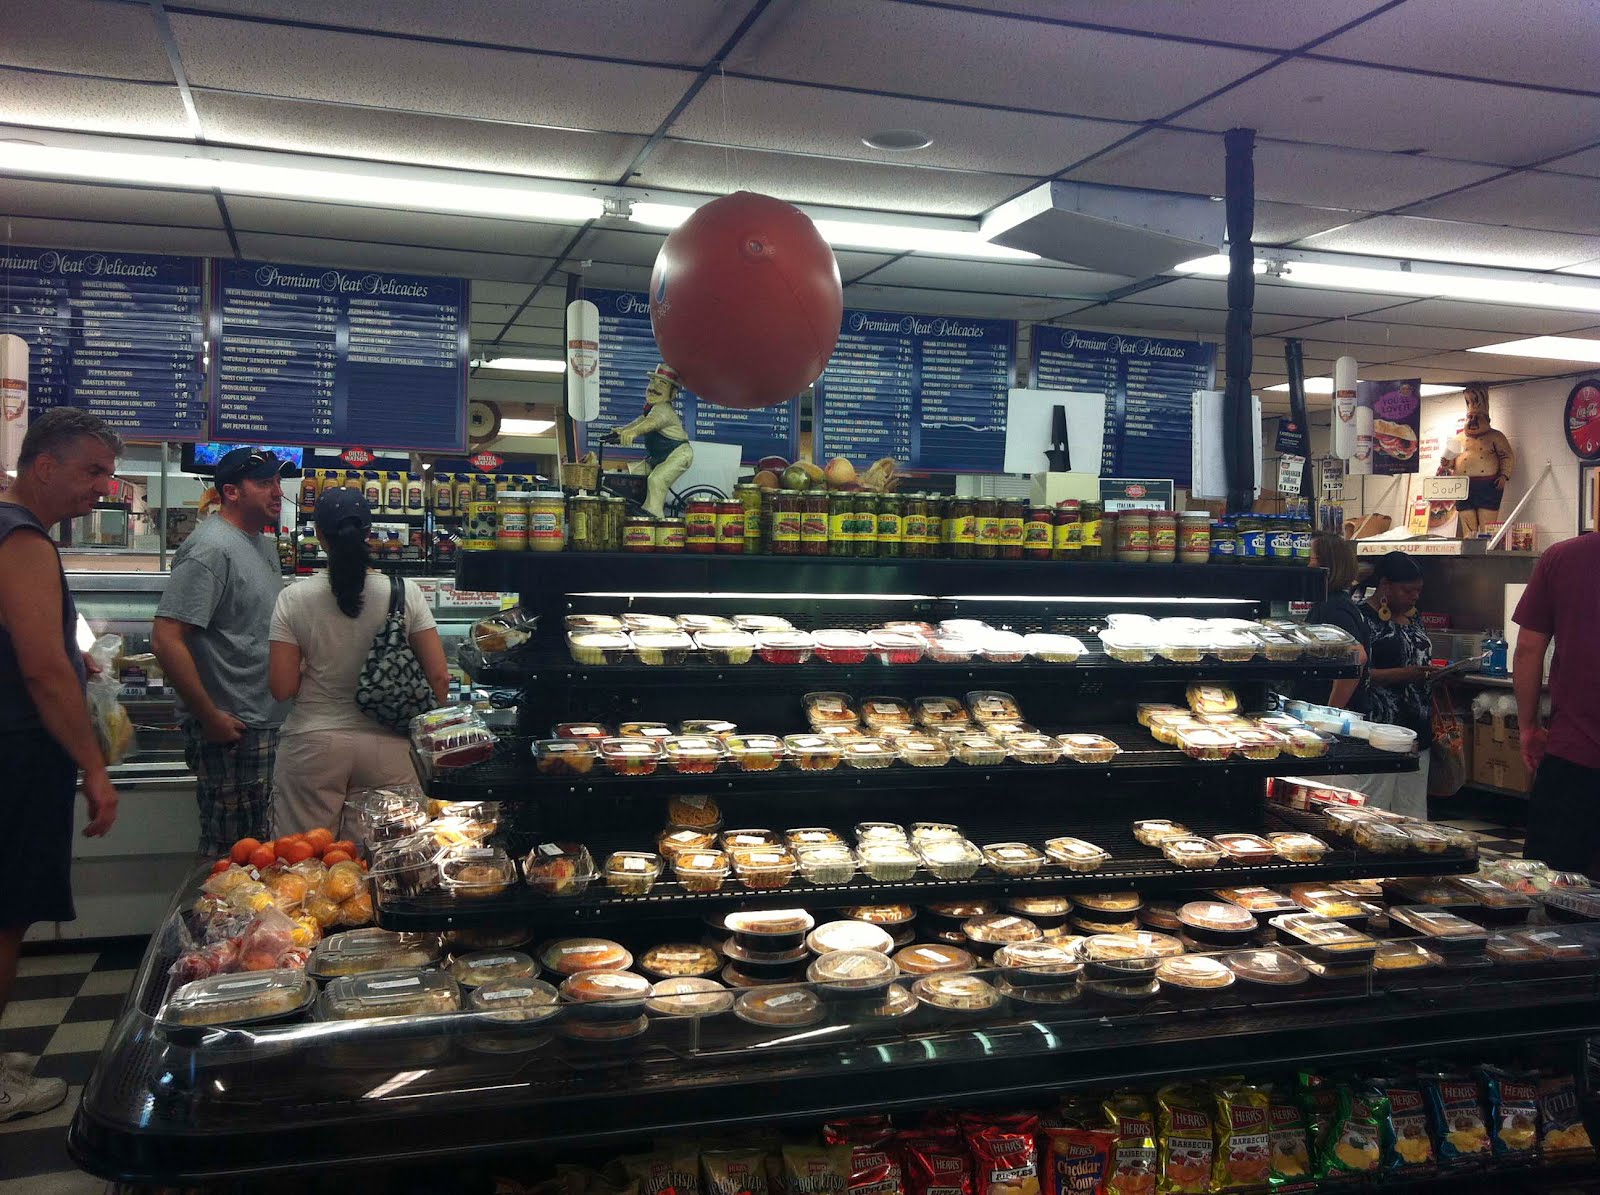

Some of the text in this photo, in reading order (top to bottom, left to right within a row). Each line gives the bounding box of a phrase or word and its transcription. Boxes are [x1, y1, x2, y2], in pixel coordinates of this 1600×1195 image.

[39, 251, 84, 274] Meat
[83, 254, 158, 277] Delicacies
[255, 265, 429, 297] Premium Meat Delicacies
[615, 293, 651, 315] Prem
[850, 312, 984, 337] Premium Meat Delicacies
[1061, 331, 1107, 351] Premium
[1135, 339, 1186, 358] Delicacies
[1586, 440, 1592, 451] 6
[1279, 484, 1299, 492] $1.29
[1425, 544, 1456, 553] KITCHEN
[1422, 615, 1447, 624] AKERY
[1057, 1160, 1102, 1177] Cheddar
[1069, 1177, 1095, 1191] Sour
